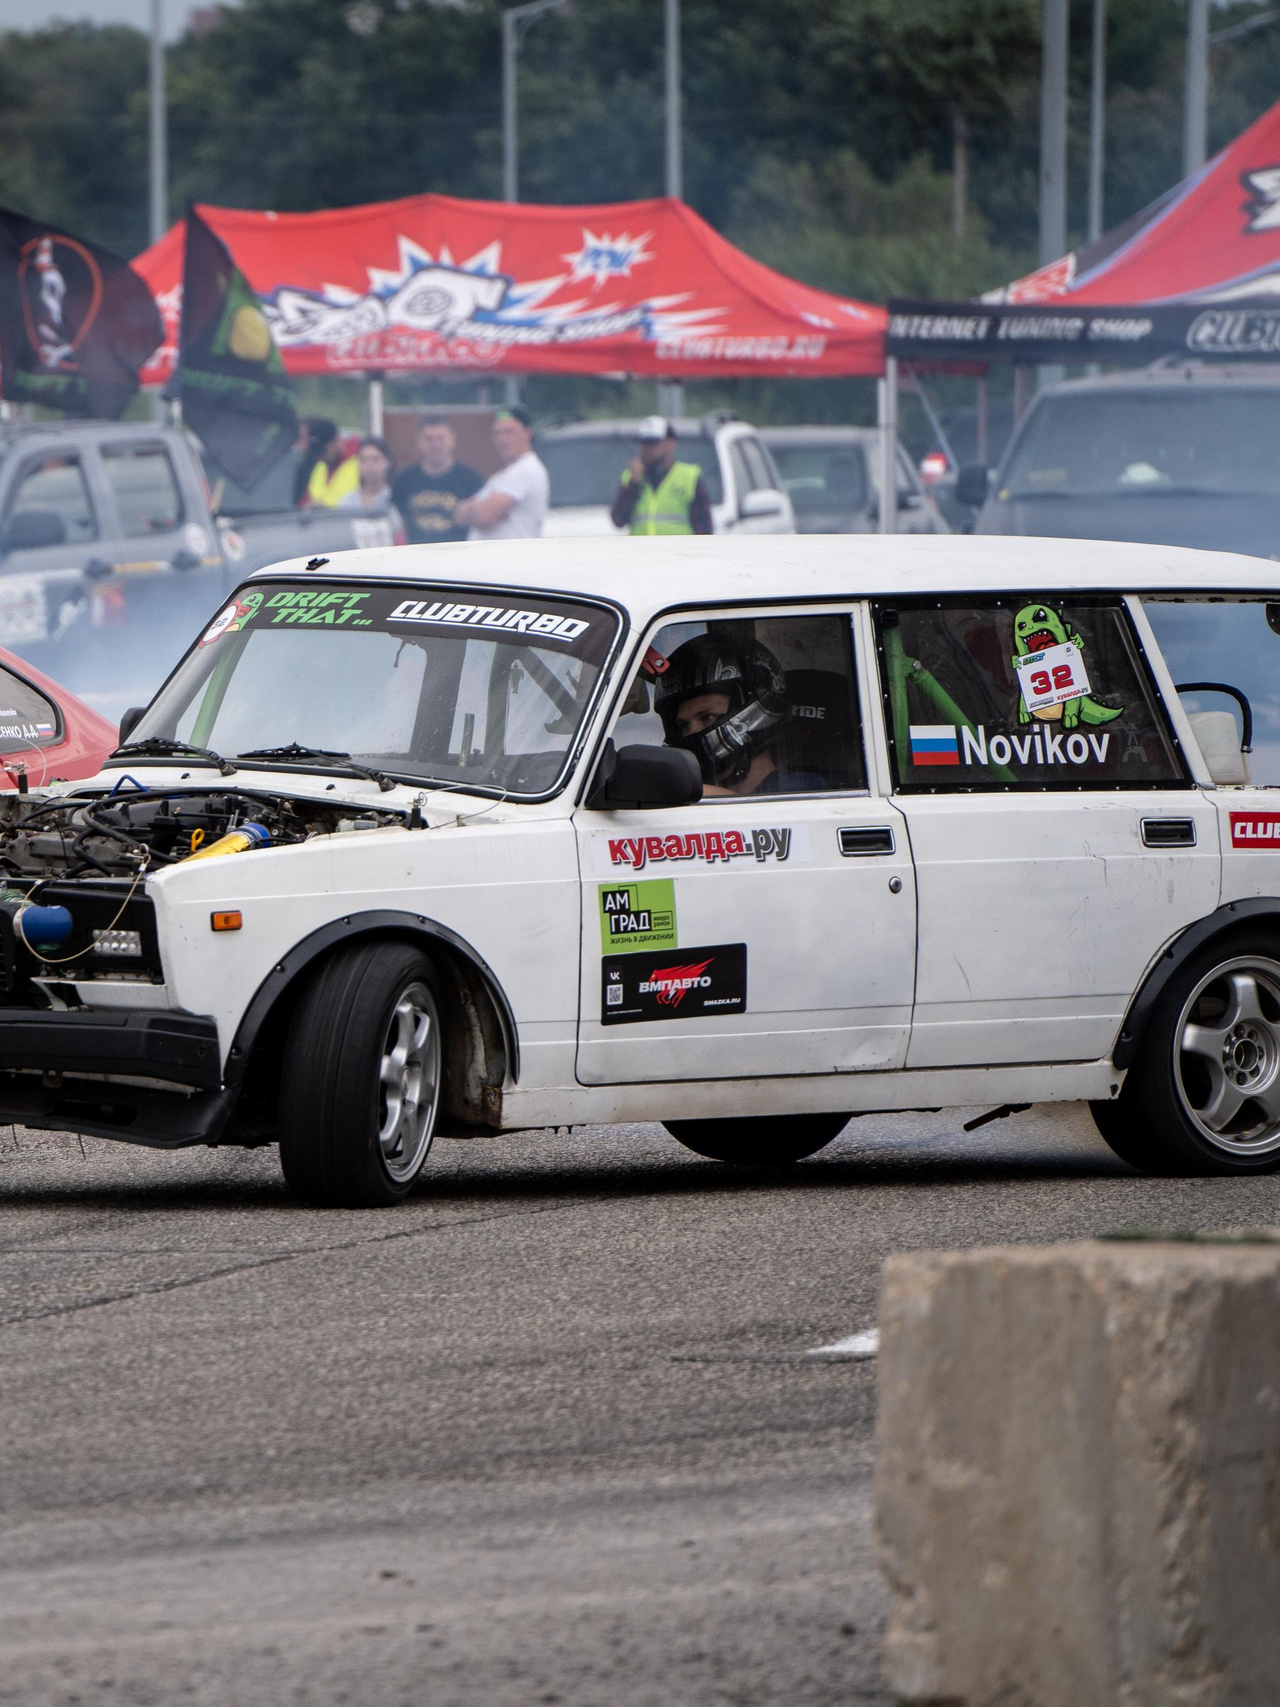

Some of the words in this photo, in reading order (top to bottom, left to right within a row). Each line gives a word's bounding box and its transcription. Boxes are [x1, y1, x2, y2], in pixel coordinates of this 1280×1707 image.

[888, 314, 992, 341] NTERNET
[1086, 316, 1153, 341] SHOP
[264, 592, 372, 608] DRIFT
[388, 601, 590, 640] CLUBTURBO
[1030, 664, 1075, 695] 32
[960, 723, 1110, 766] Novikov
[607, 827, 791, 870] кувалда.ру
[604, 892, 629, 911] АМ
[610, 912, 650, 932] ГРАД
[610, 935, 633, 944] ЖИЗНЬ
[638, 933, 675, 943] ДВИЖЕНИИ
[639, 976, 712, 994] ВМПАВТО
[703, 997, 742, 1006] SMAZKA.RU
